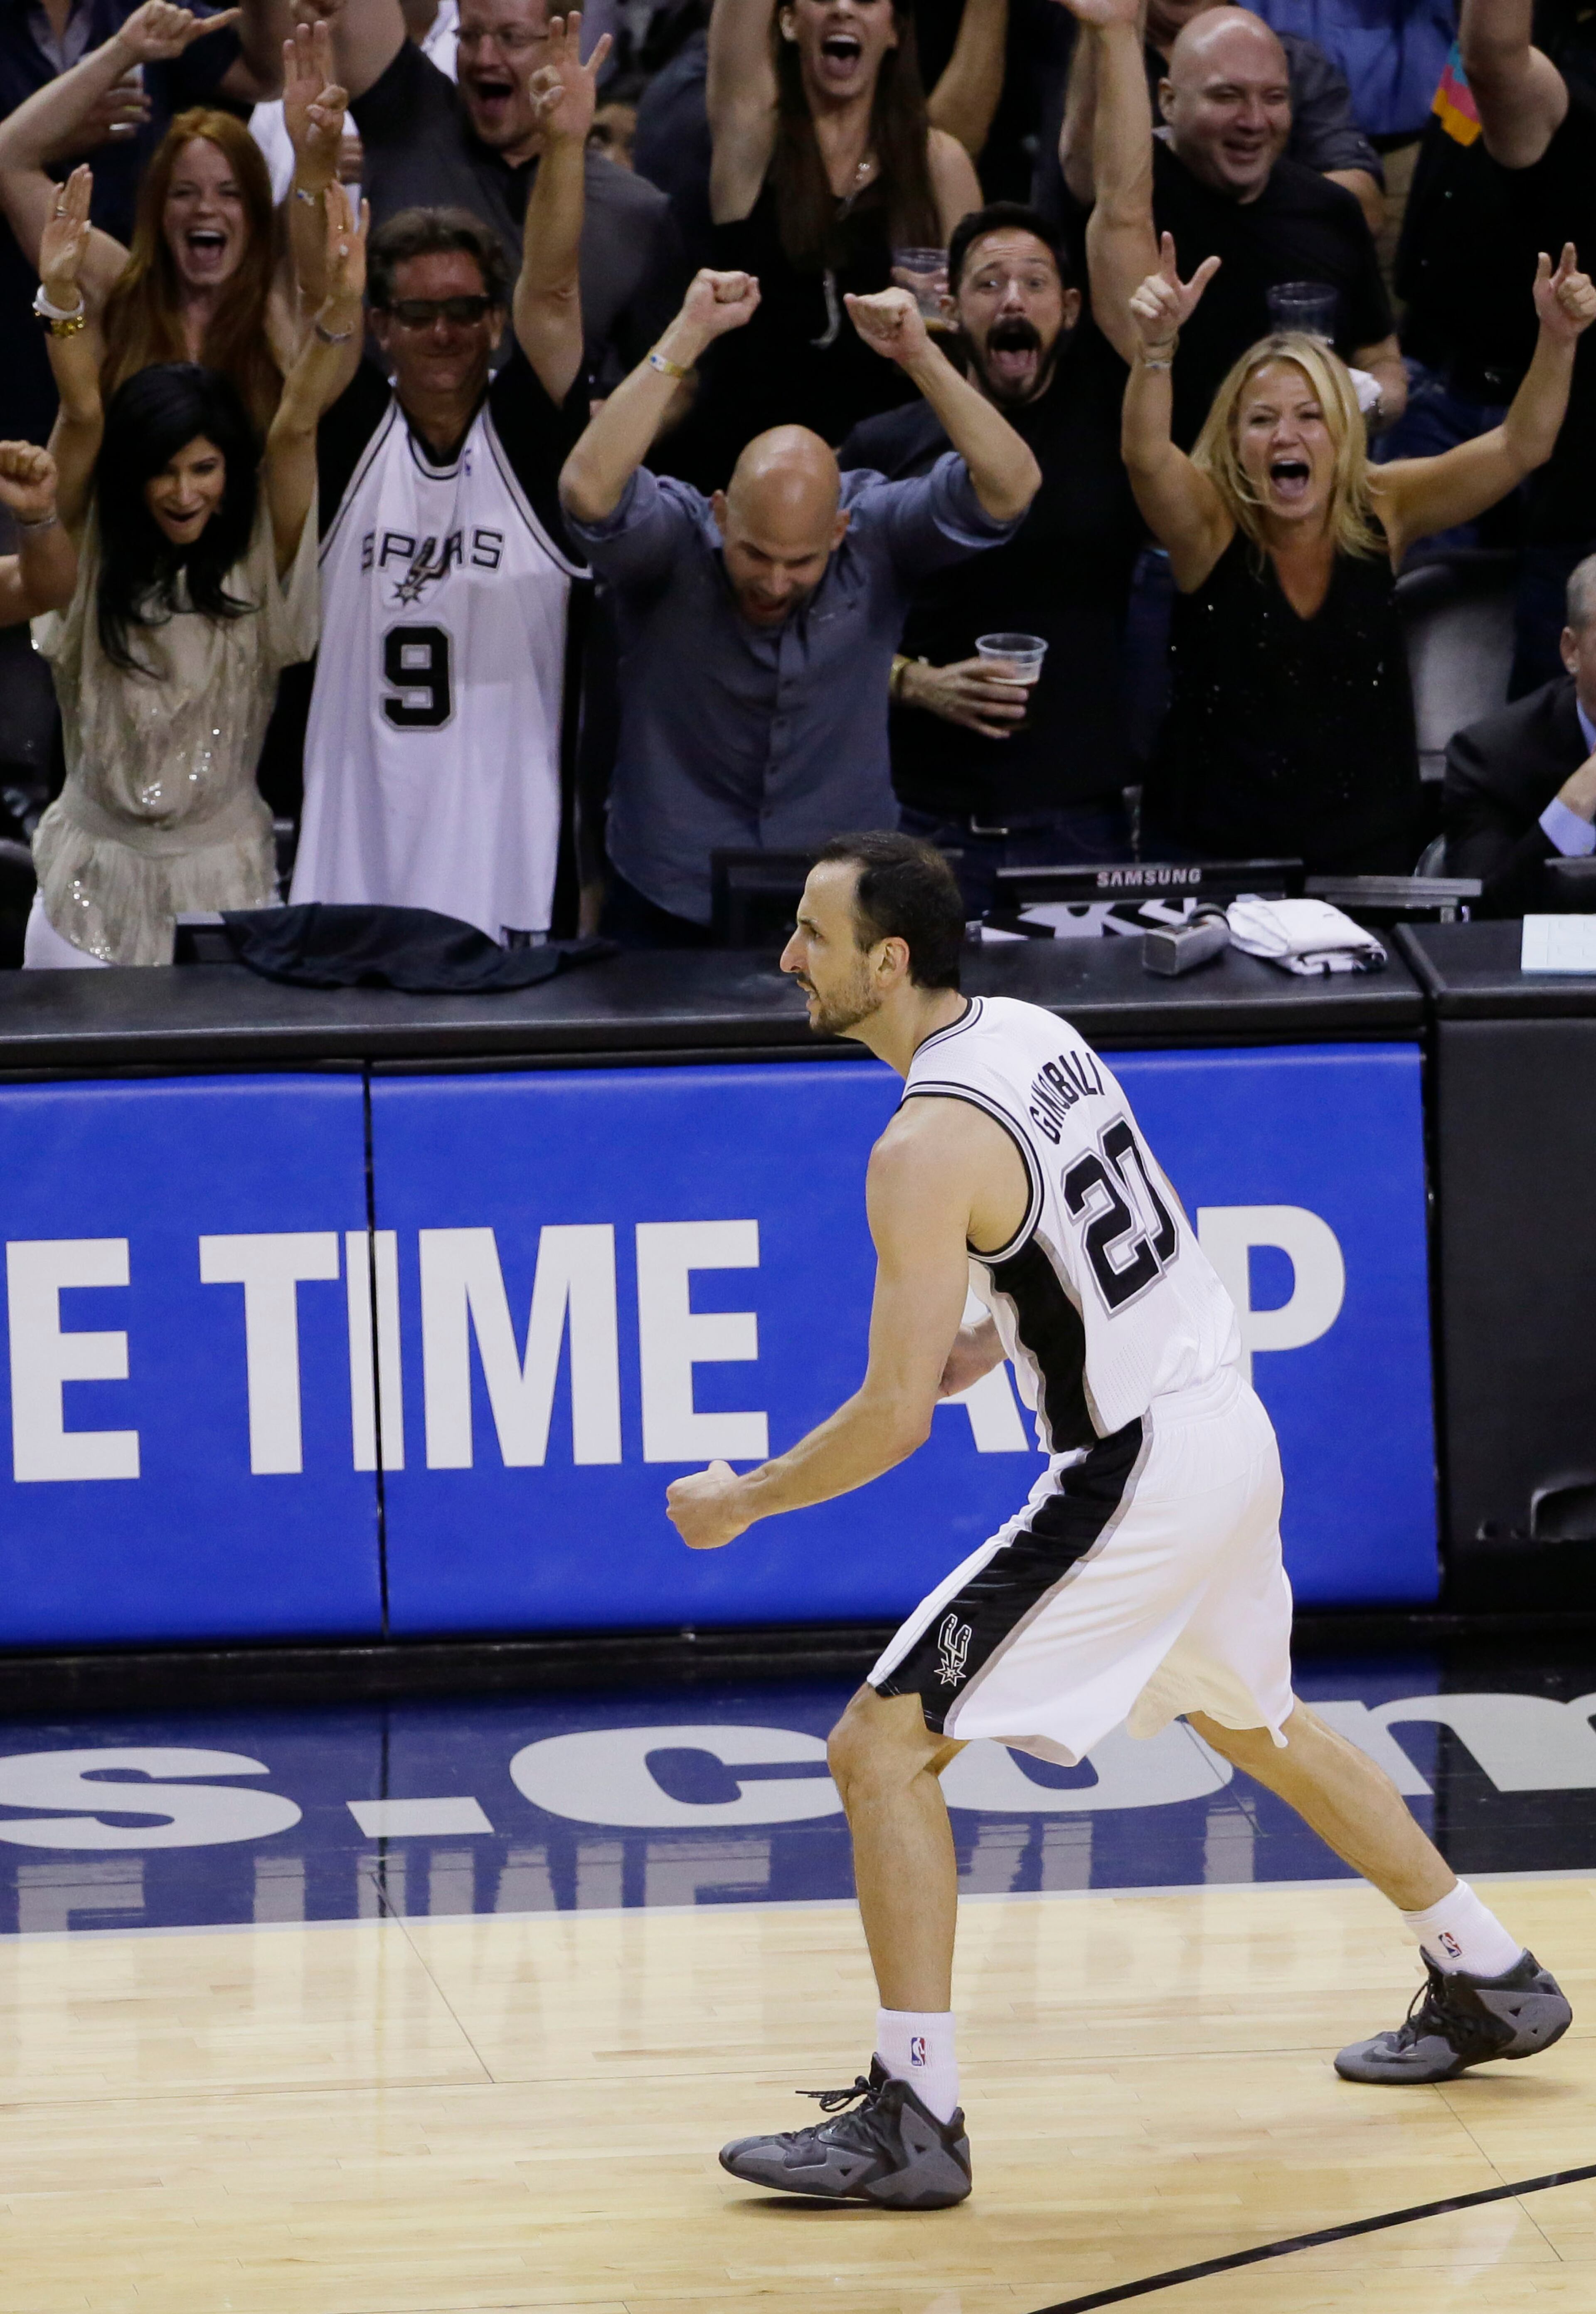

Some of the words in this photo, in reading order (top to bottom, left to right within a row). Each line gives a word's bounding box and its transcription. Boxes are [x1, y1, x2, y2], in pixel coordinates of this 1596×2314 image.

[382, 623, 455, 729] 9
[1097, 868, 1202, 888] SAMSUNG
[1029, 1050, 1106, 1145] GINOBILI
[1060, 1111, 1180, 1321] 20
[199, 1219, 770, 1475] TIME
